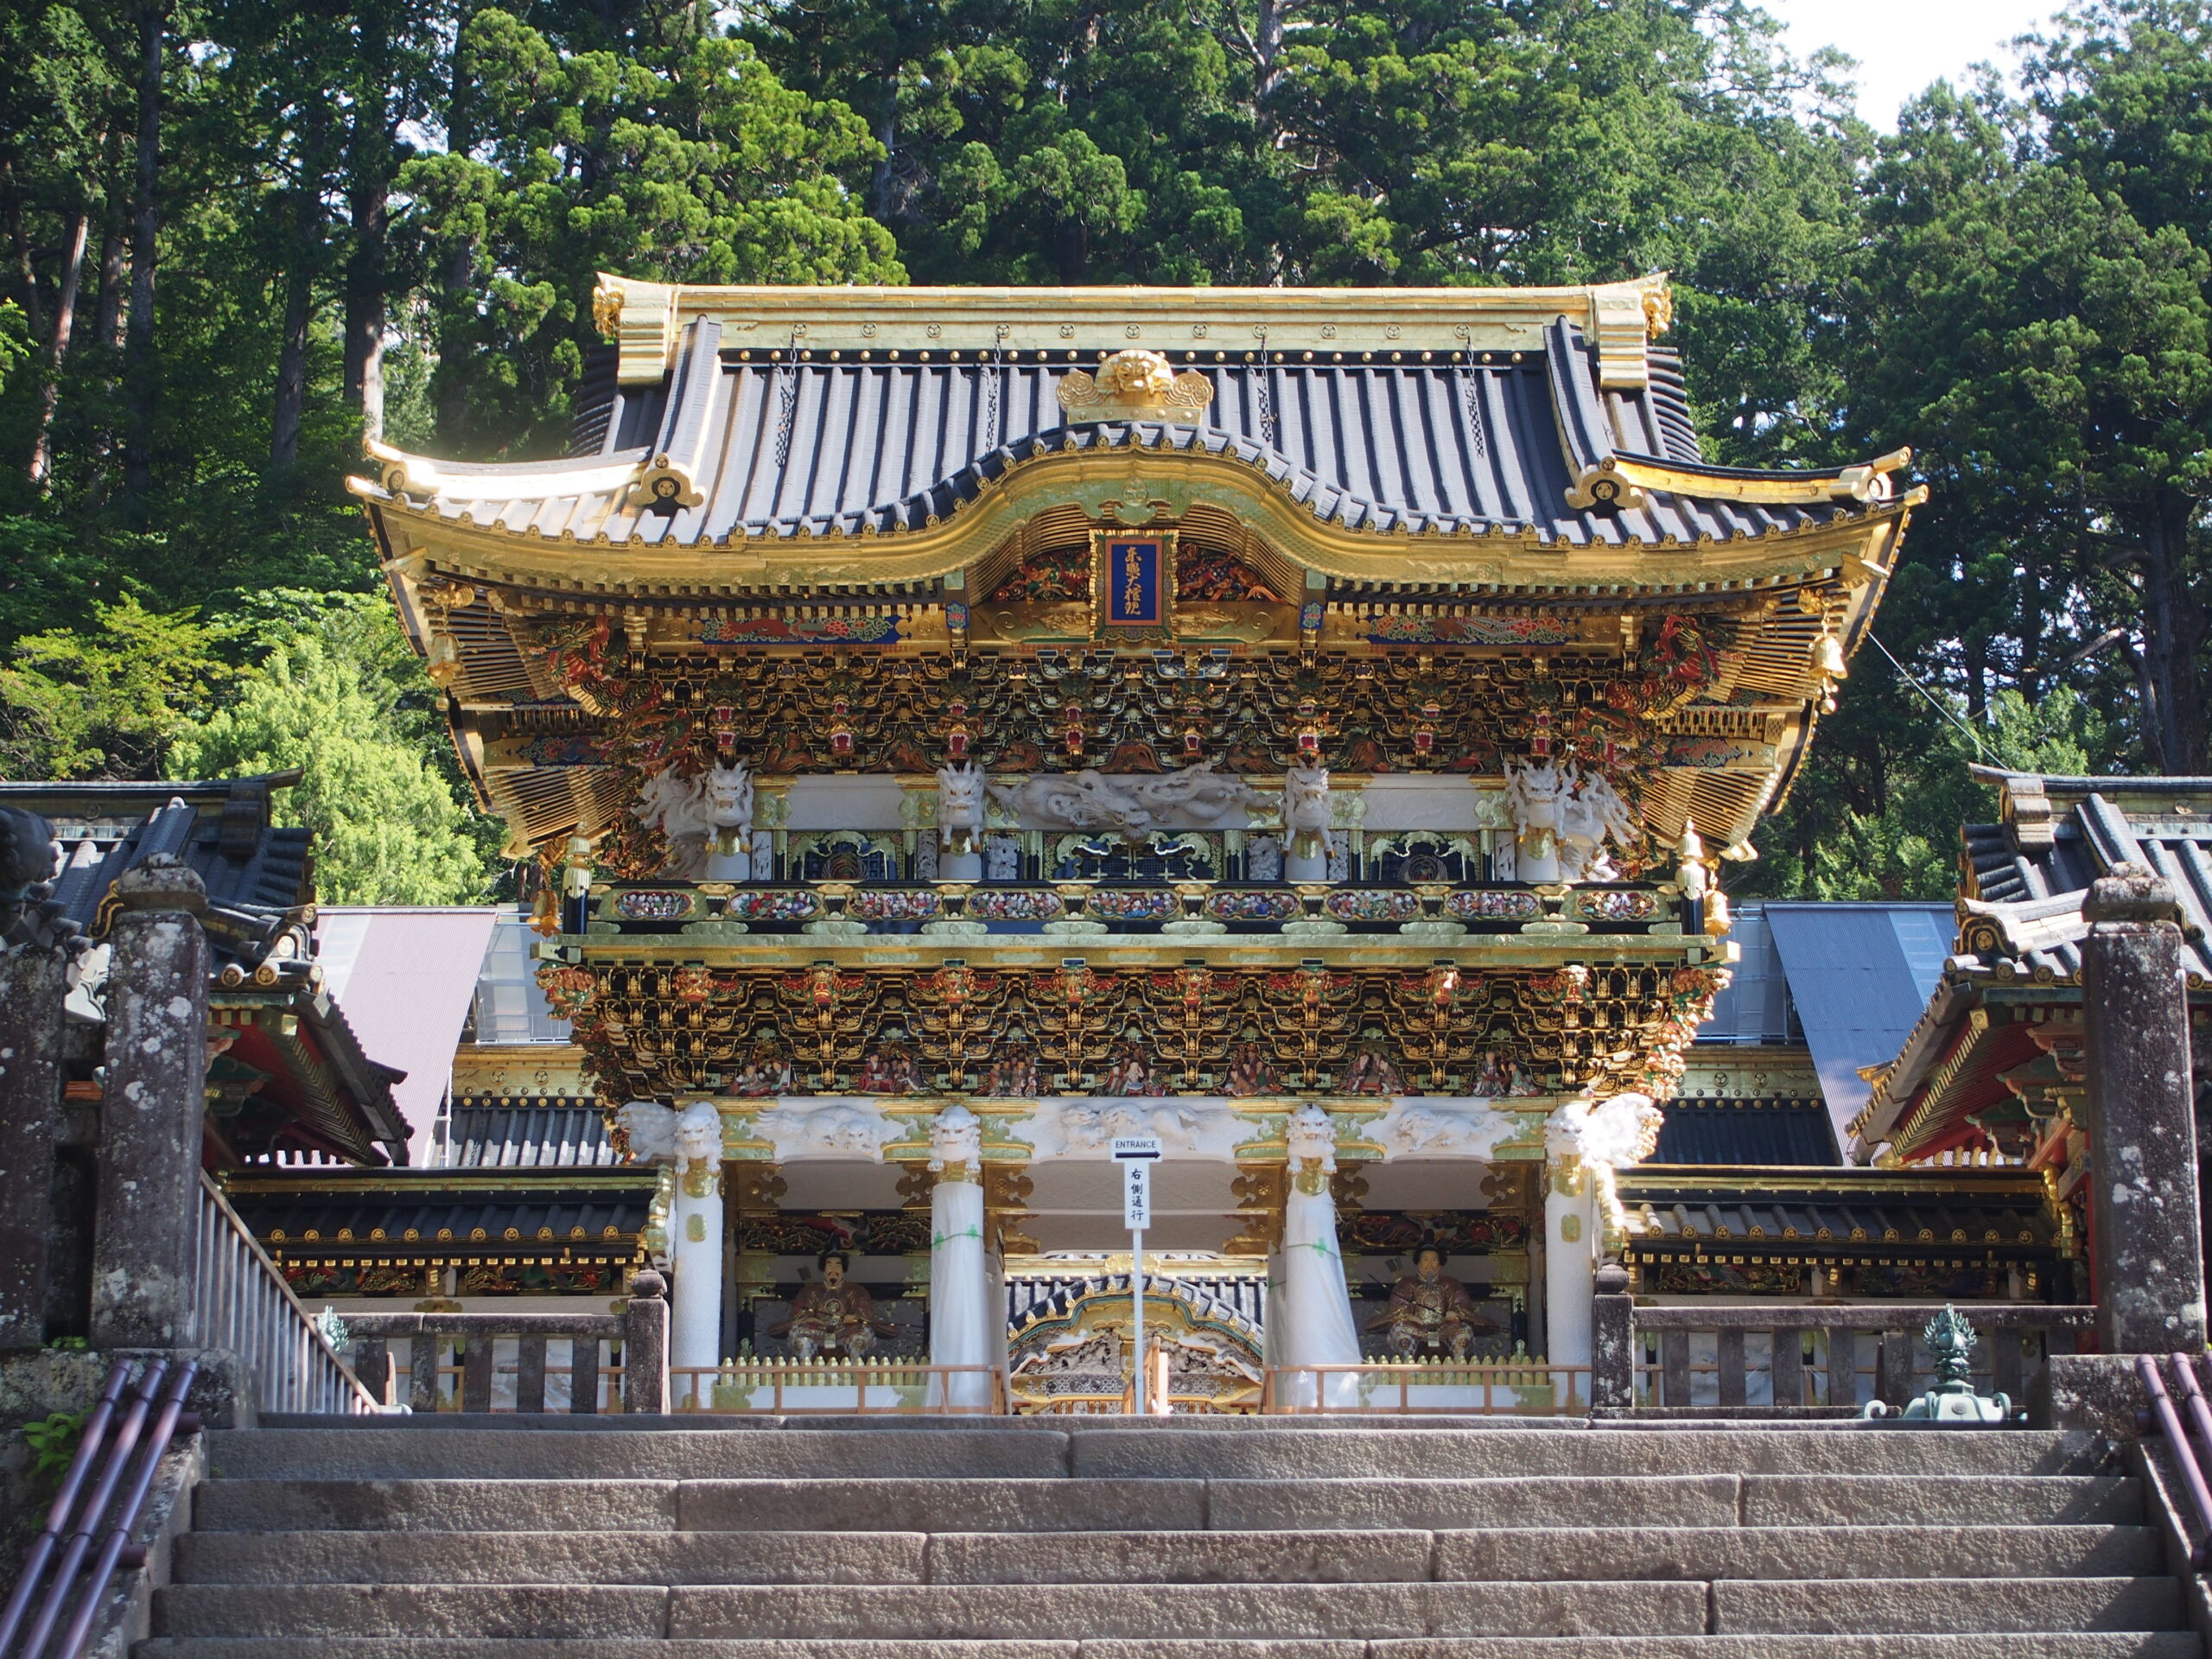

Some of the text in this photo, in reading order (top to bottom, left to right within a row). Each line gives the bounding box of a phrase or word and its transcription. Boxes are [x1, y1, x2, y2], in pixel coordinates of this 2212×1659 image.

[1115, 1140, 1156, 1148] ENTRANCE
[1129, 1167, 1144, 1221] 右側通行
